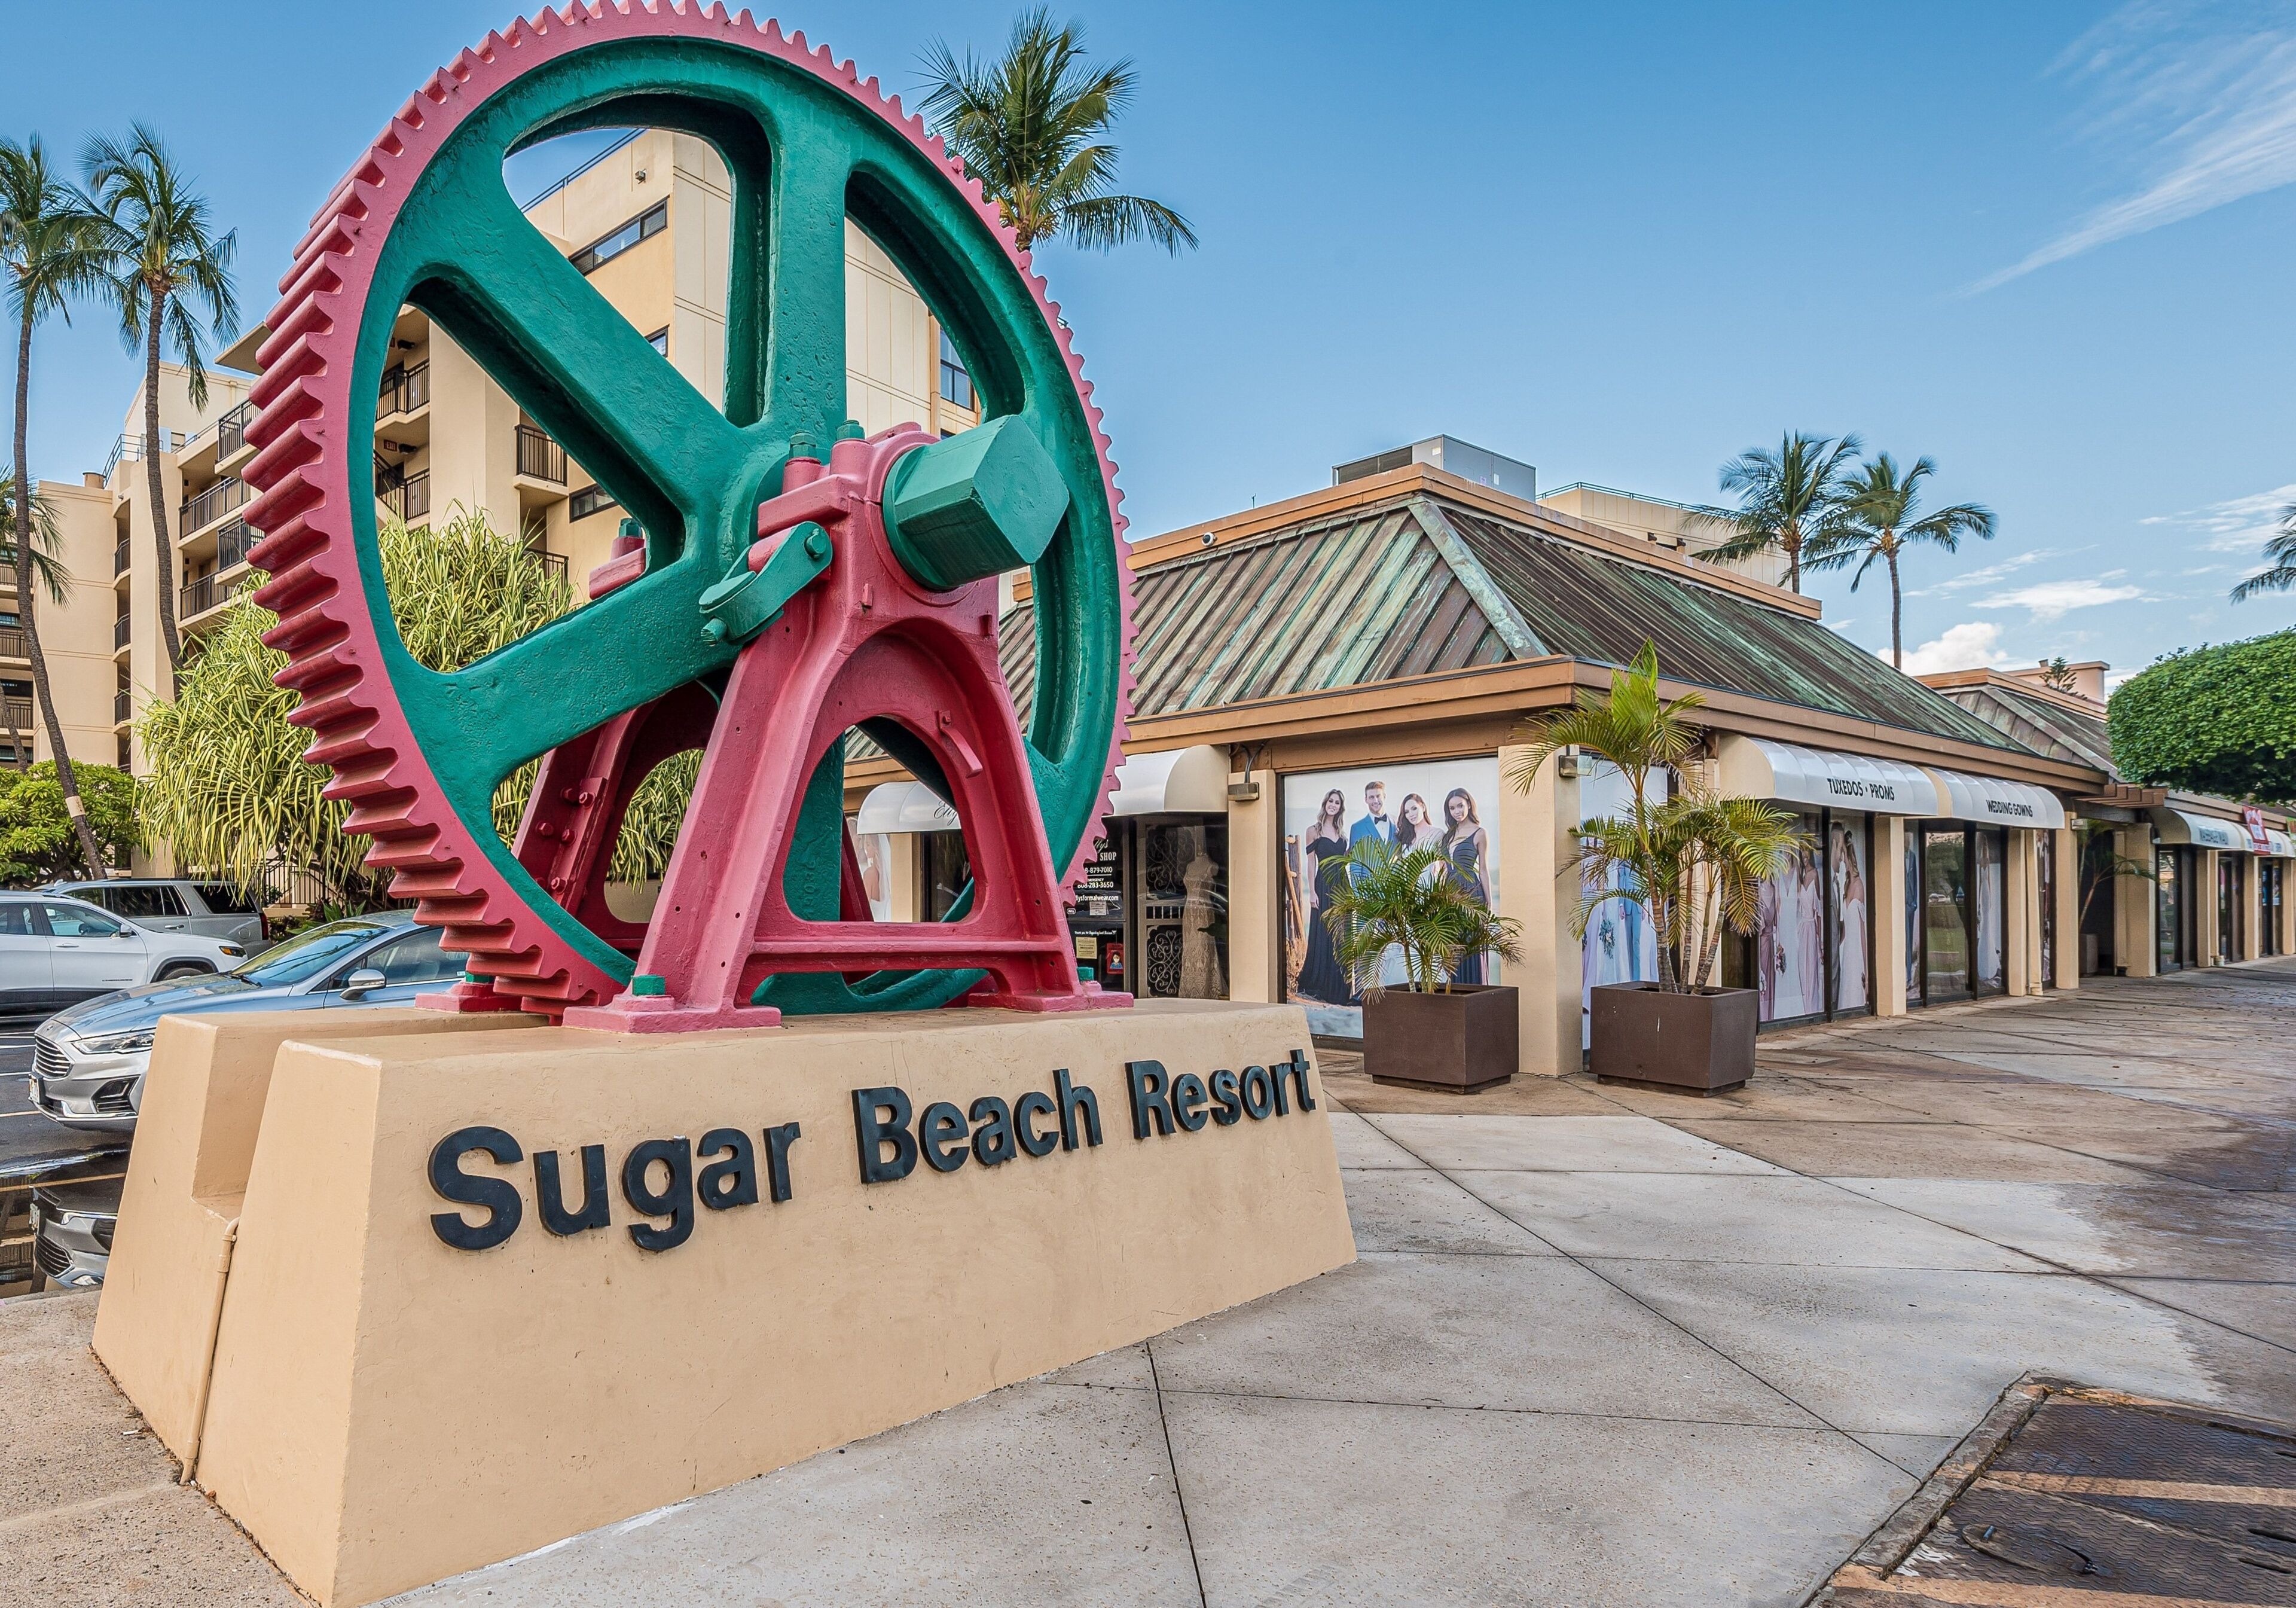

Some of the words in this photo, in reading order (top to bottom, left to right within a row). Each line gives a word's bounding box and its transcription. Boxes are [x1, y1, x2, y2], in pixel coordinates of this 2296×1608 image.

[1827, 778, 1864, 797] TUXEDOS
[1869, 783, 1895, 801] PROMS
[1986, 800, 2013, 815] WEDDING
[2013, 803, 2033, 817] GOWNS
[1100, 852, 1117, 861] SHOP
[427, 1122, 802, 1251] Sugar
[851, 1068, 1104, 1184] Beach
[1124, 1049, 1316, 1139] Resort
